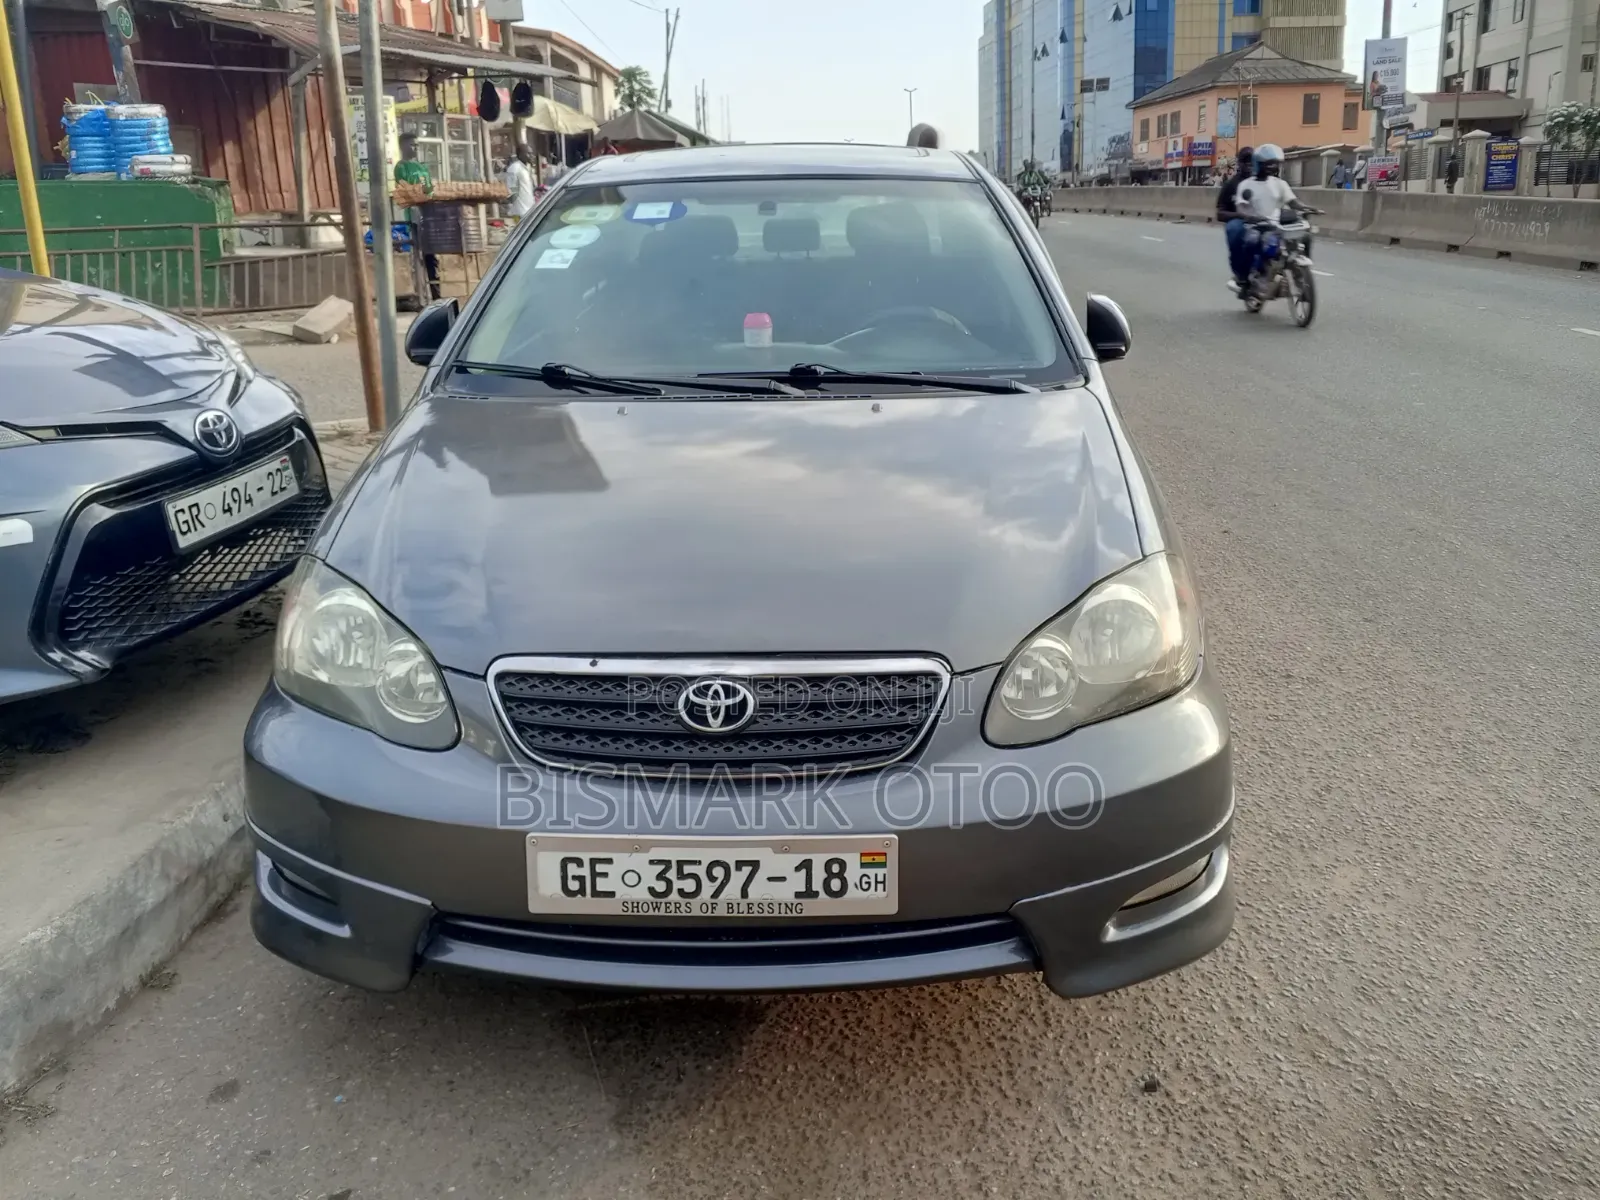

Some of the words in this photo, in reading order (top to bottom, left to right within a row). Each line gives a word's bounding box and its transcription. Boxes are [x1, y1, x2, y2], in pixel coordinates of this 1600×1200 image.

[174, 502, 206, 537] GR
[222, 468, 287, 516] 494-22
[560, 856, 616, 898] GE
[647, 857, 848, 899] 3597-18
[859, 873, 887, 893] GH
[621, 901, 693, 914] SHOWERS
[699, 901, 718, 914] OF
[726, 901, 804, 914] BLESSING
